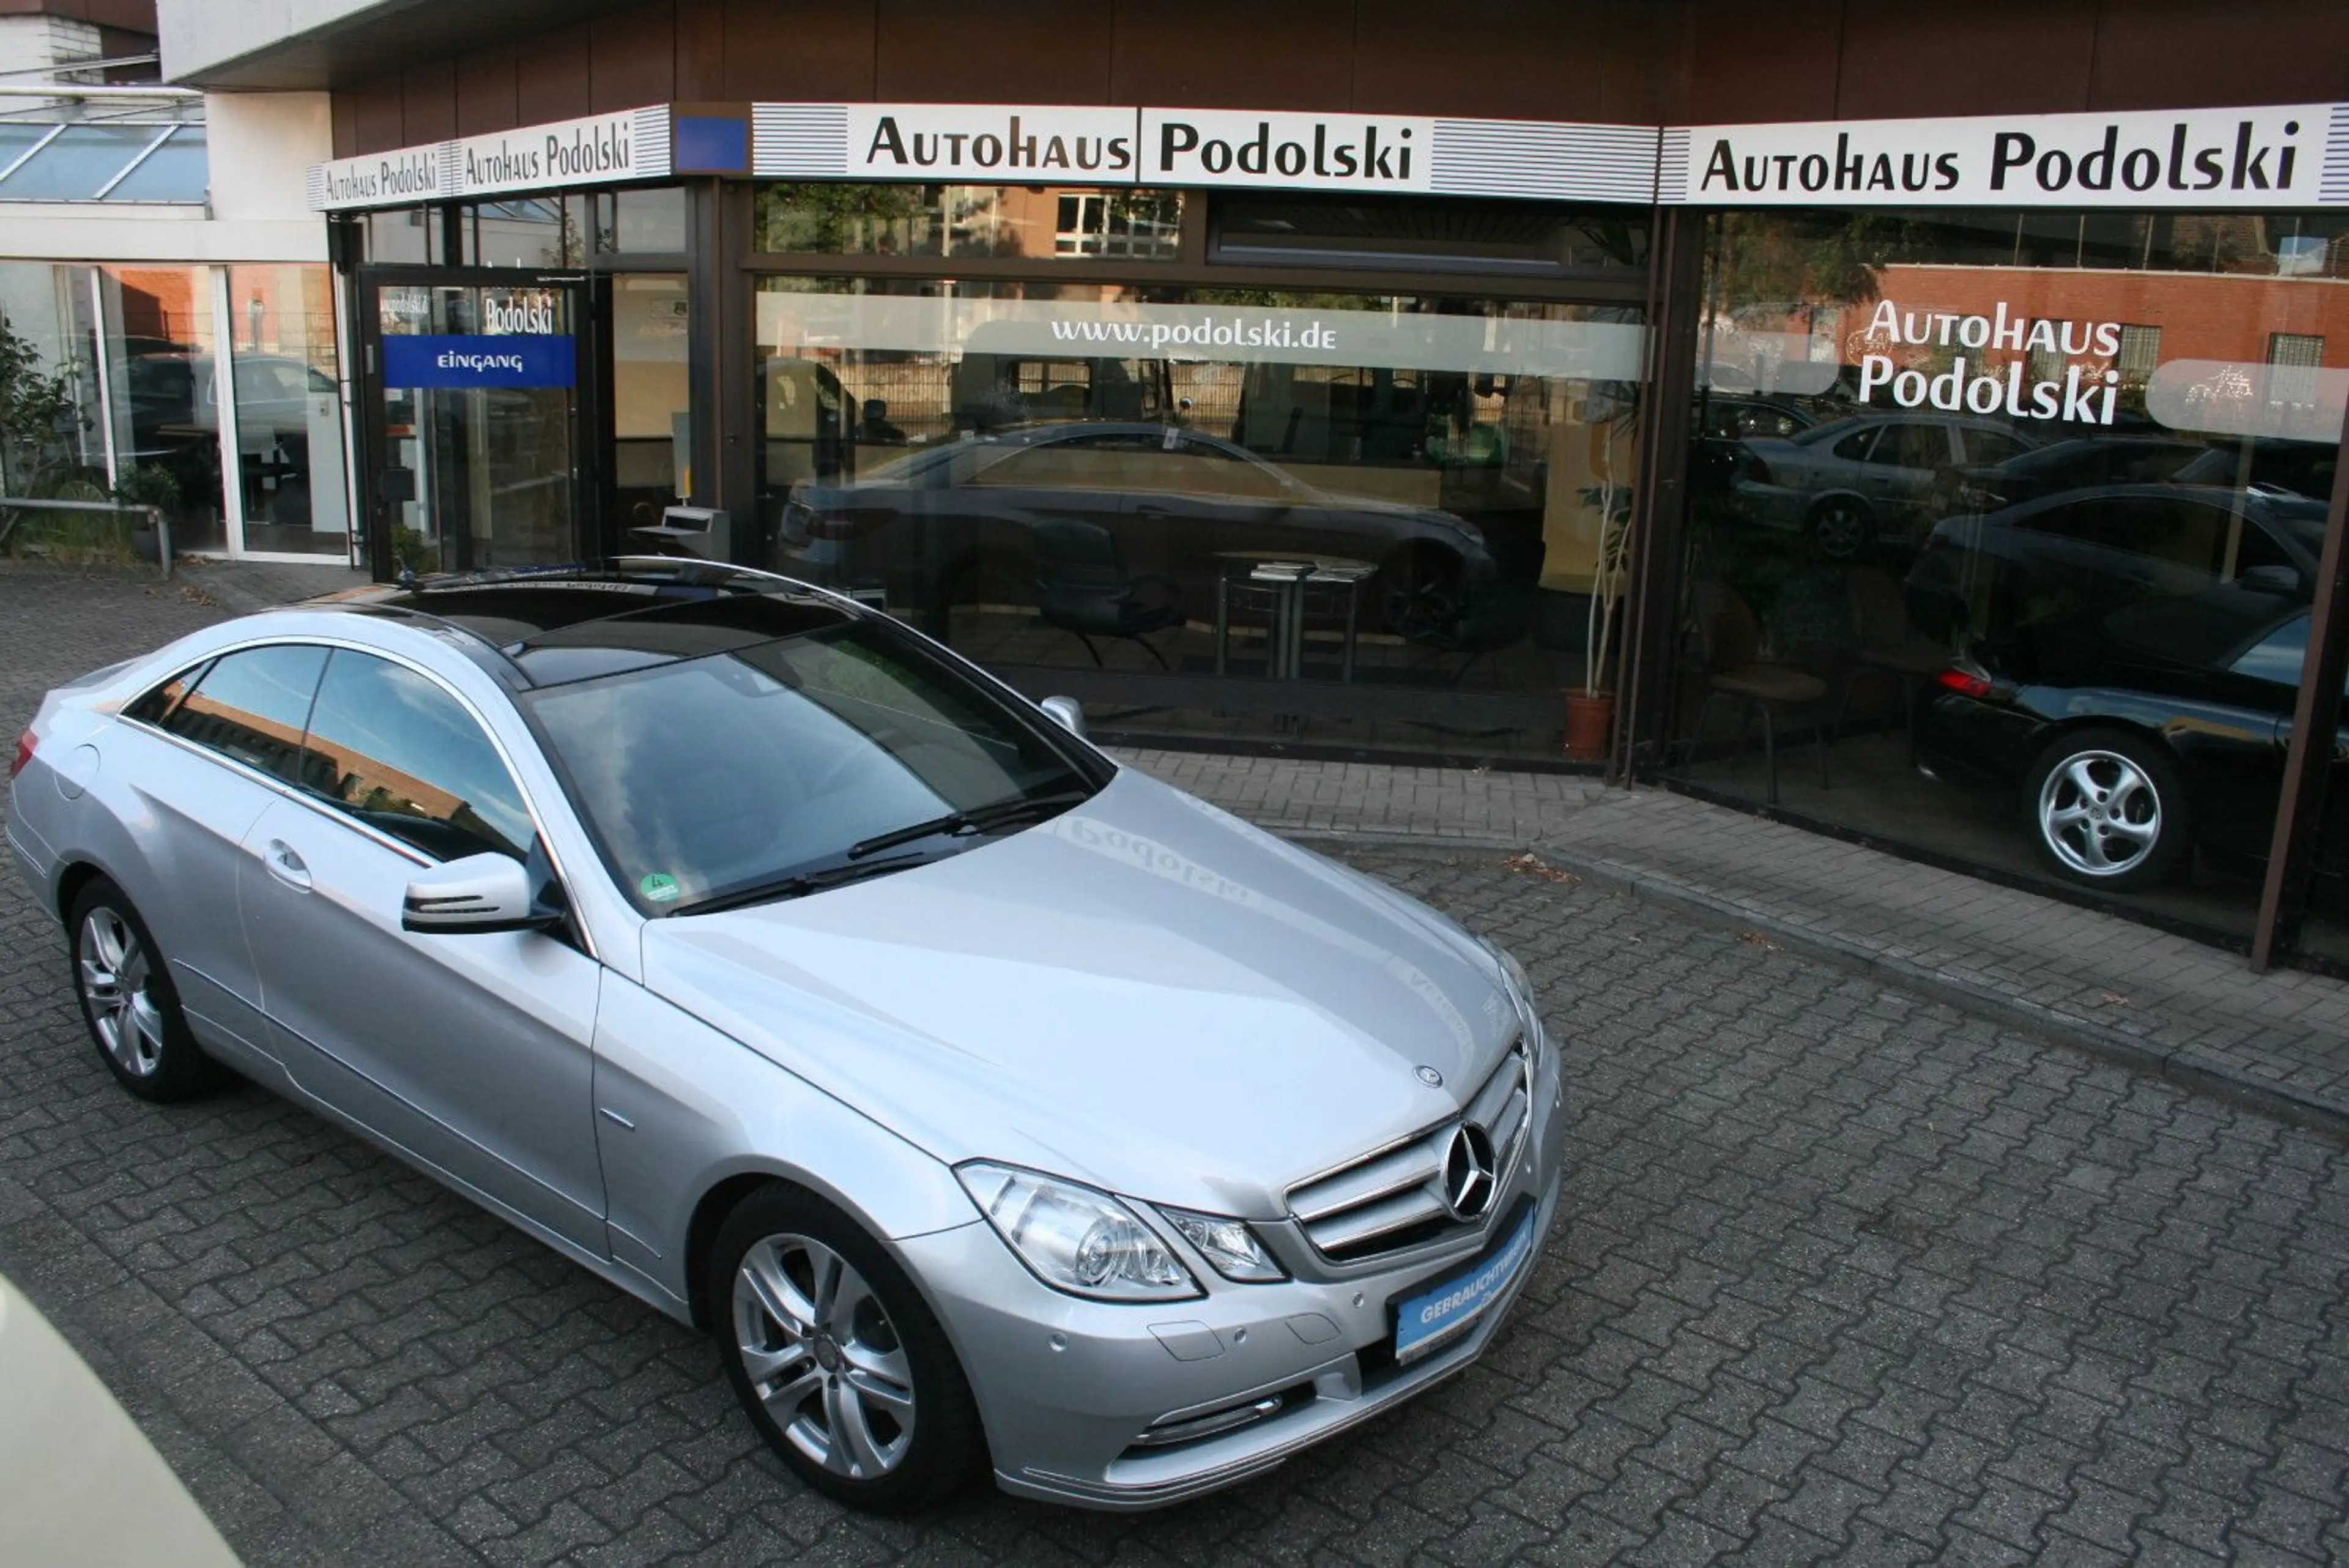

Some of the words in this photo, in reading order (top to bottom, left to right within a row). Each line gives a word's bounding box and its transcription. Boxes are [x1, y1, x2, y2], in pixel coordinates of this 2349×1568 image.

[547, 122, 629, 177] Podolski
[1160, 121, 1412, 180] Podolski
[1989, 121, 2300, 191] Podolski
[380, 153, 437, 195] Podolski
[485, 295, 552, 334] Podolski
[1052, 318, 1338, 349] www.podolski.de
[1858, 355, 2119, 425] Podolski
[652, 875, 665, 887] 4
